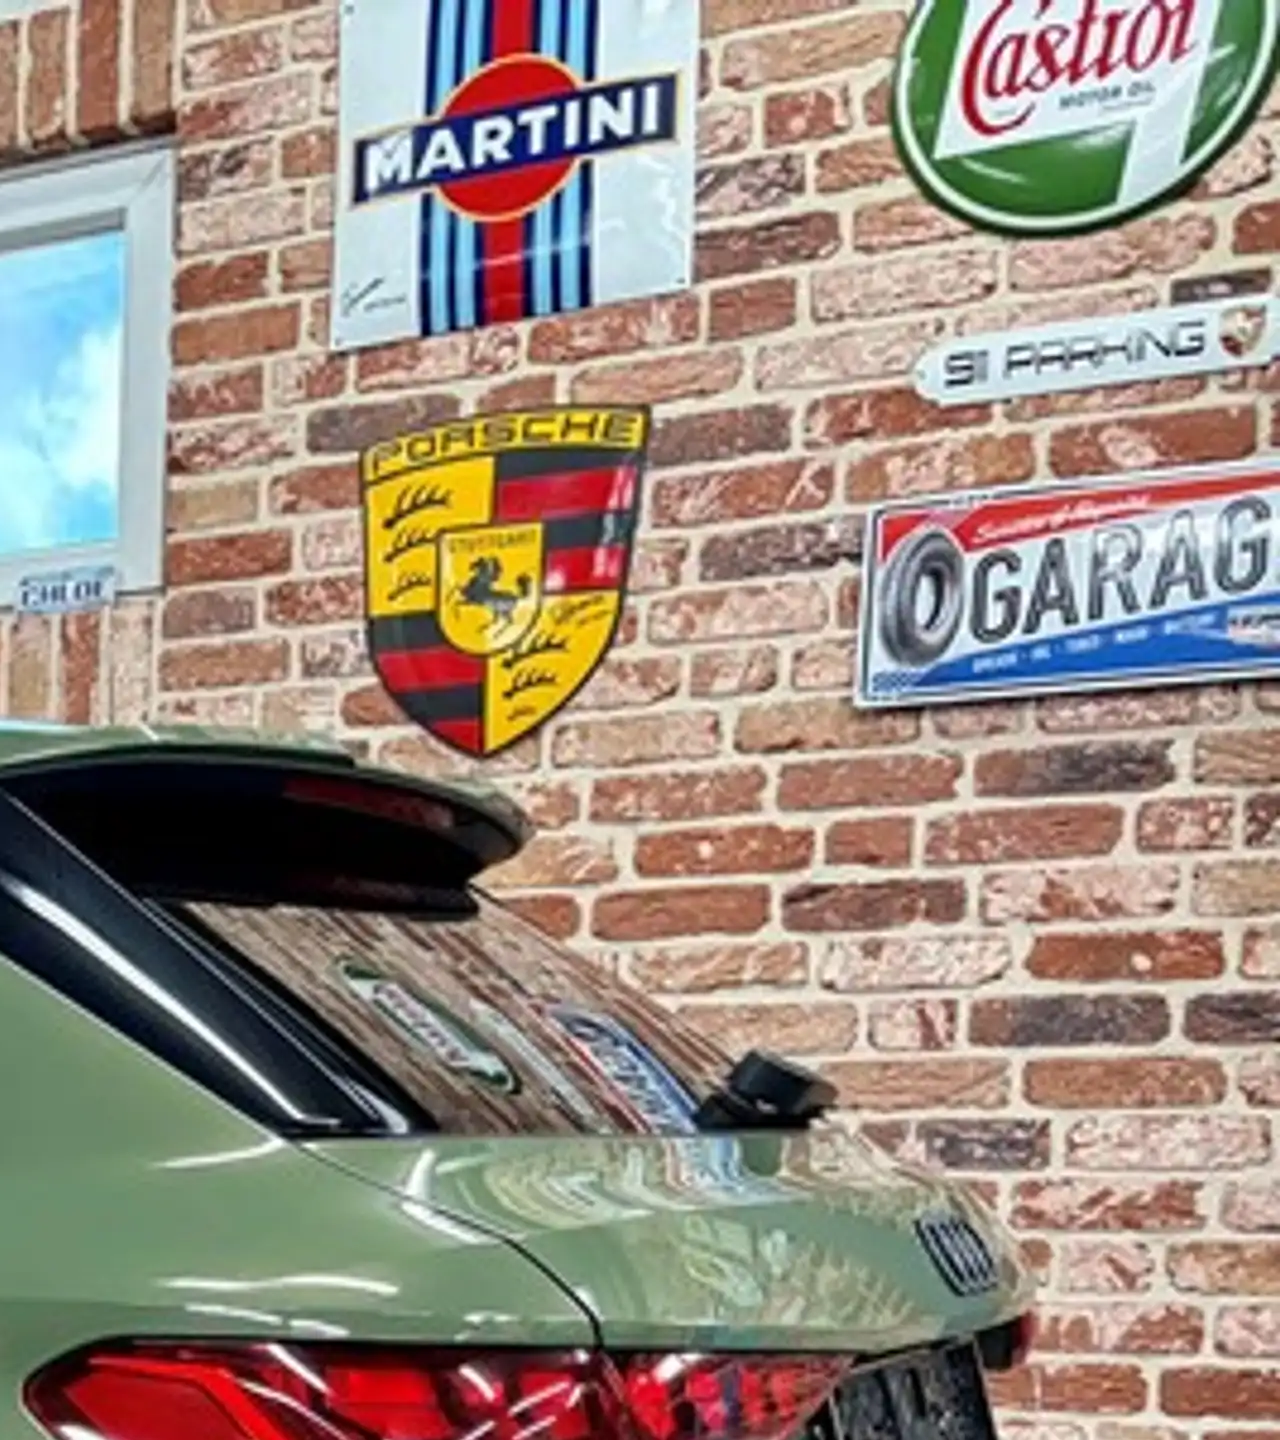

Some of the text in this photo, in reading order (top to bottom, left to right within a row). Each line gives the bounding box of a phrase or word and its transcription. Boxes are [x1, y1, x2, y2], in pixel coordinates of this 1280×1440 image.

[363, 84, 660, 193] MARTINI
[1003, 321, 1205, 381] PARKING
[371, 411, 639, 476] PORSCHE
[969, 497, 1280, 644] GARAG
